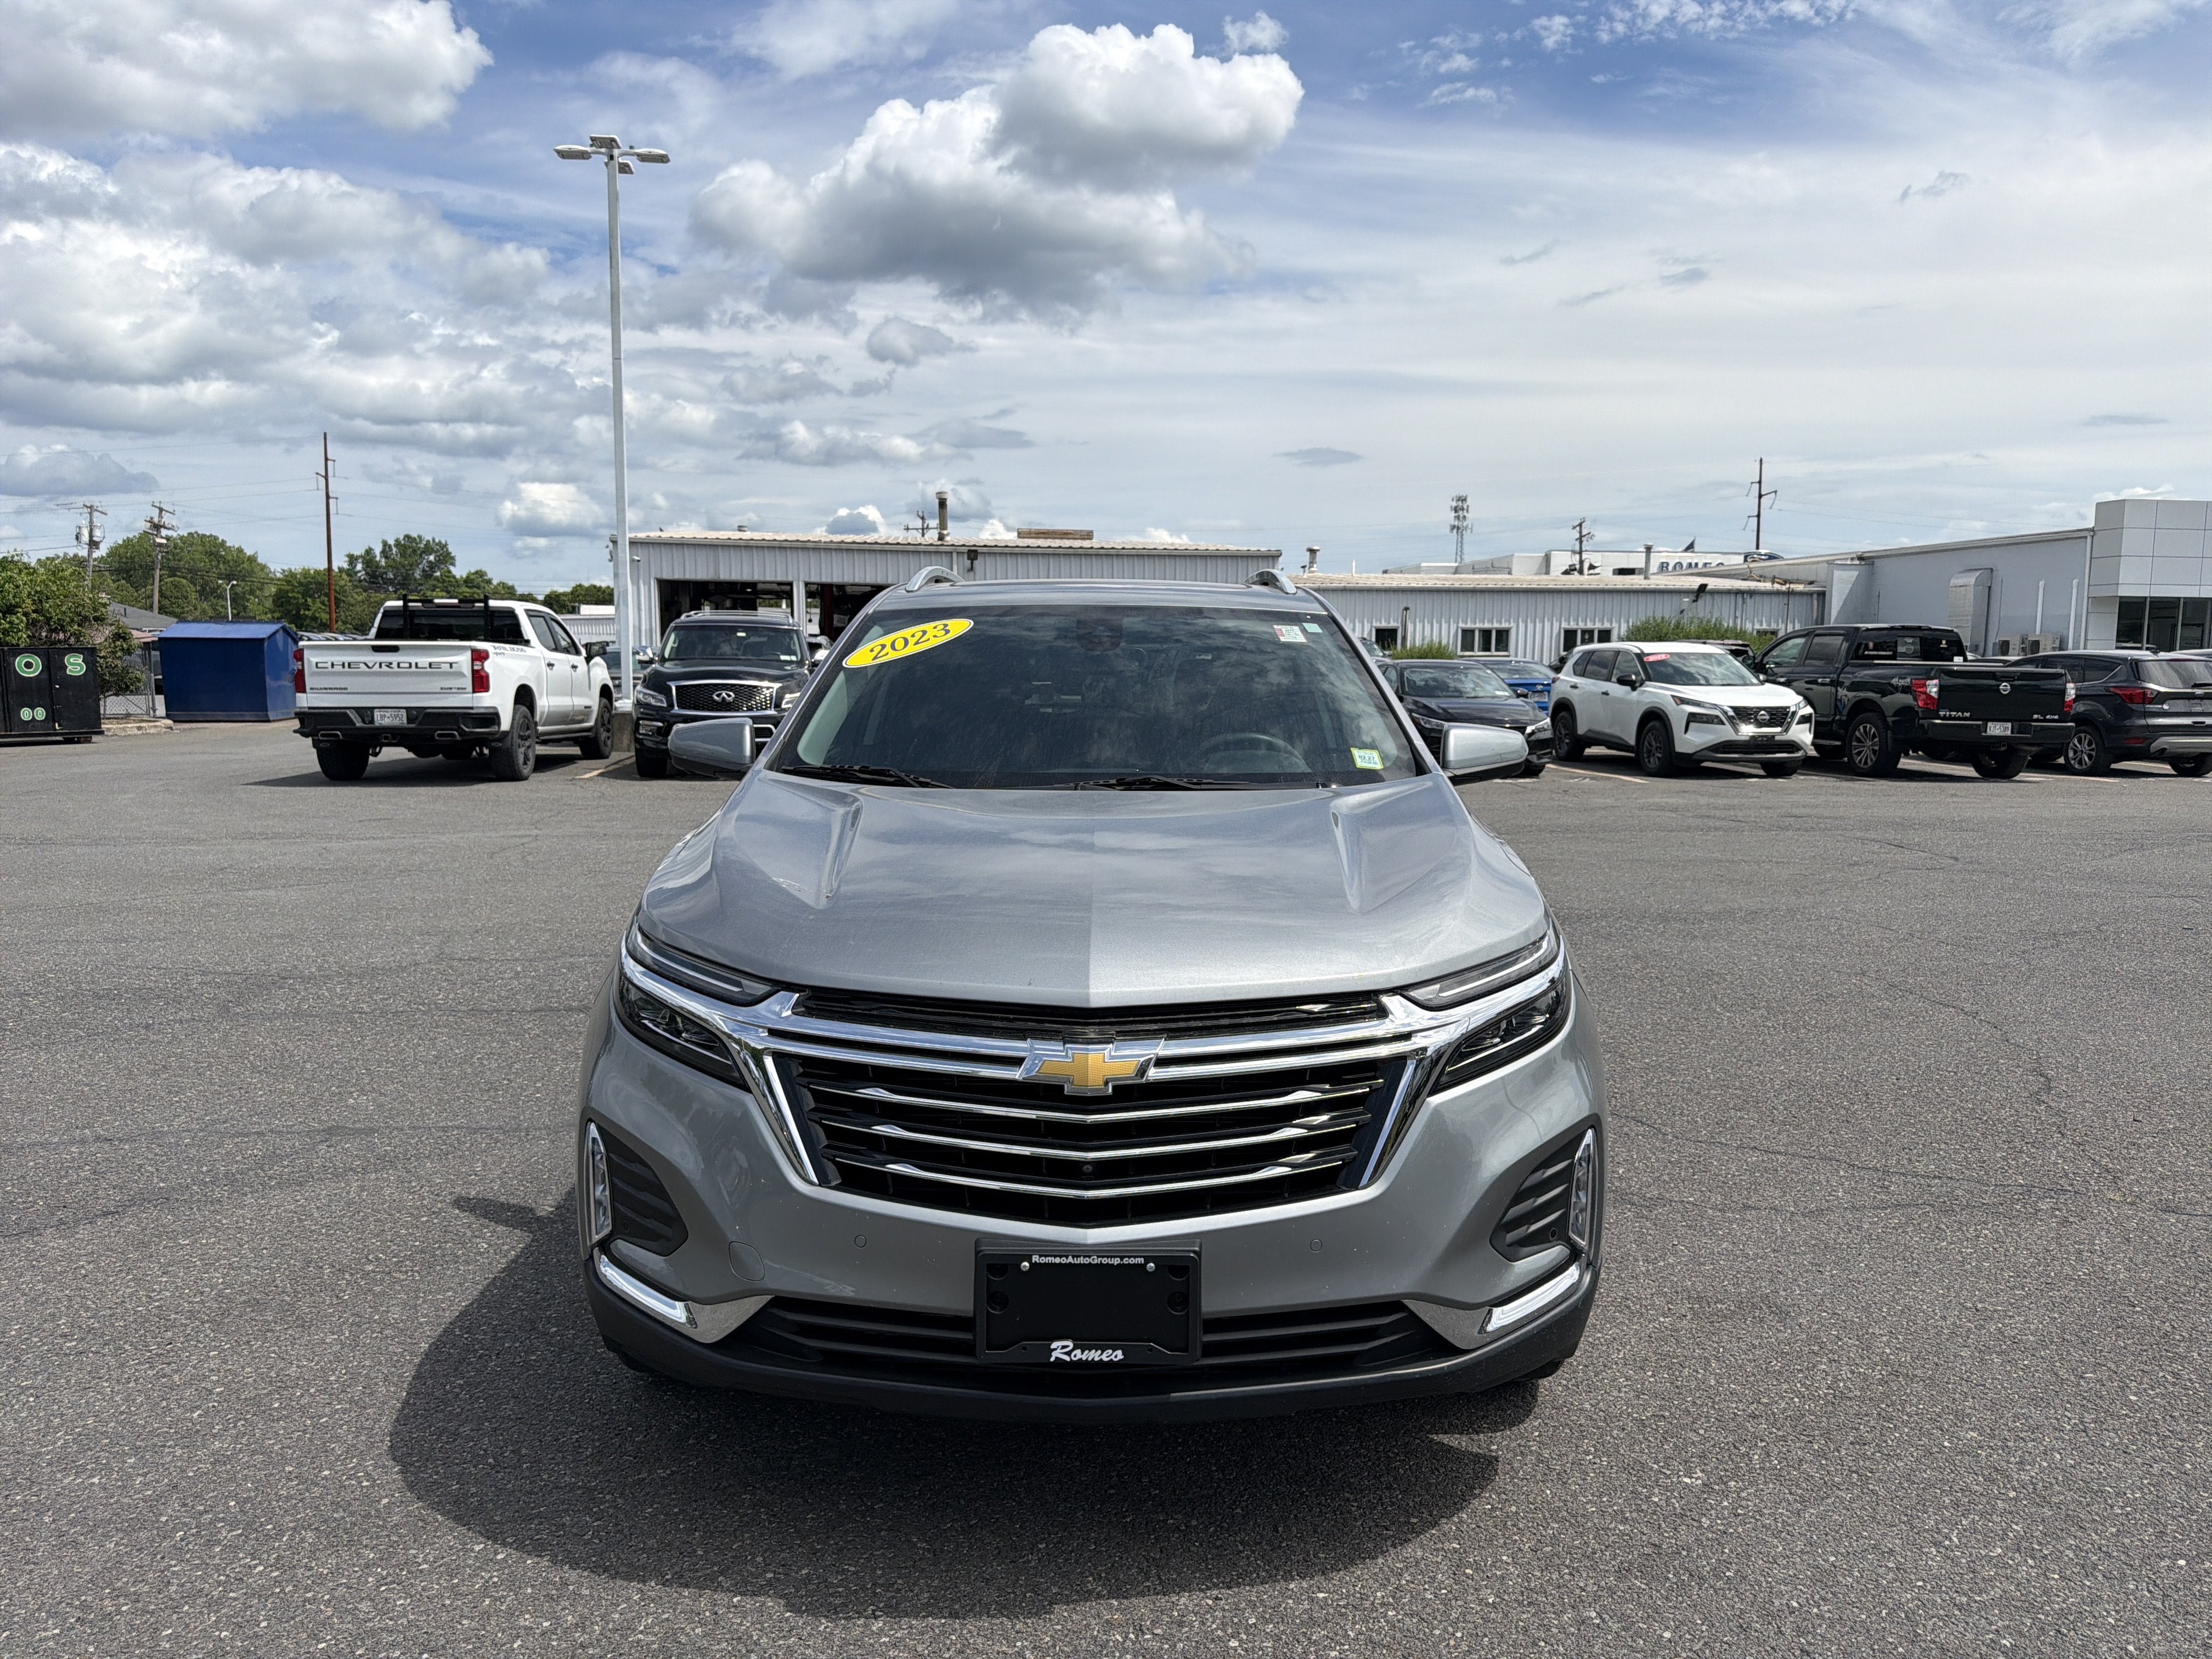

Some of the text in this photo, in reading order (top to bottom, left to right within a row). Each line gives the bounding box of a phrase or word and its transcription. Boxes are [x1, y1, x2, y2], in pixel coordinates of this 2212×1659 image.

[869, 623, 951, 662] 2023
[315, 661, 459, 669] CHEVROLET
[1032, 1255, 1144, 1265] RomeoAutoGroup.com
[1049, 1341, 1124, 1362] Romeo
